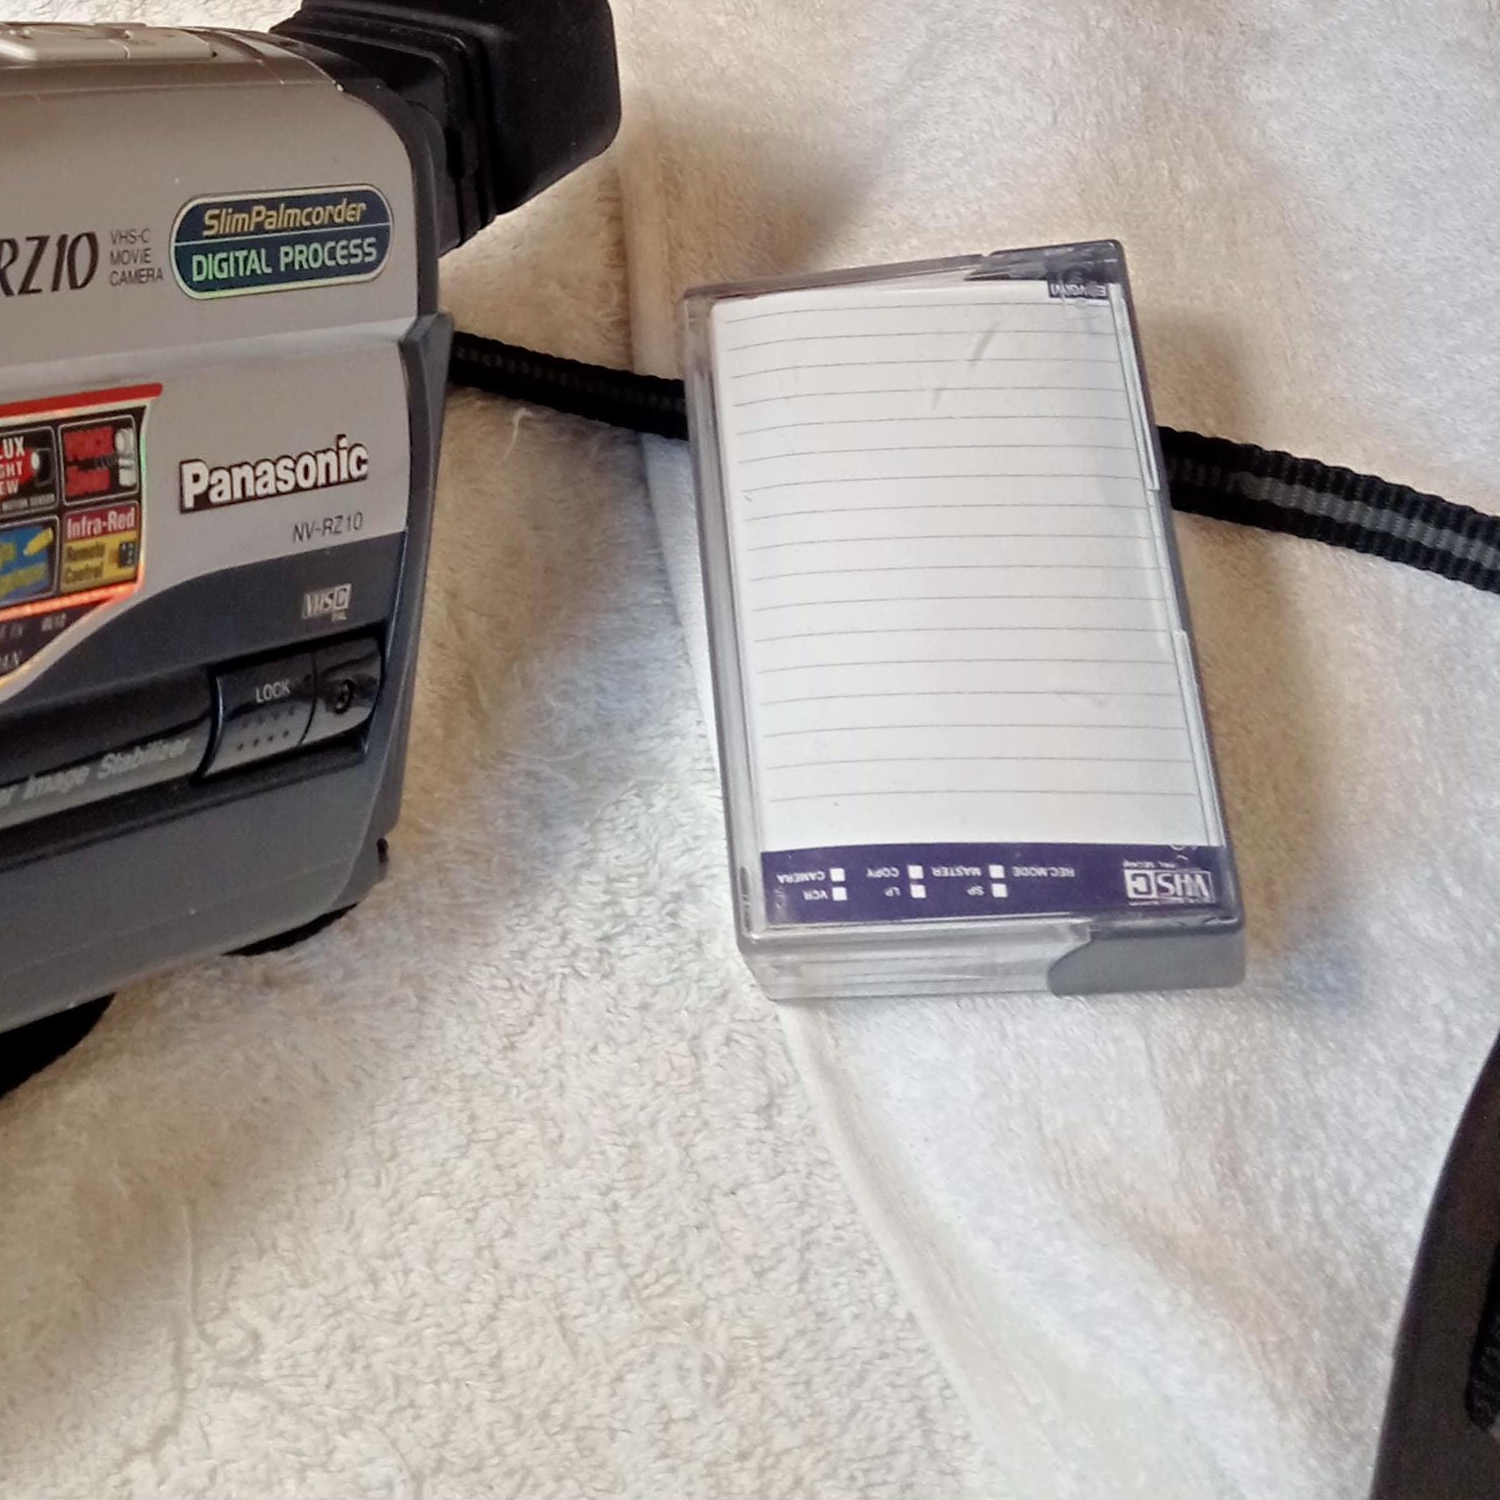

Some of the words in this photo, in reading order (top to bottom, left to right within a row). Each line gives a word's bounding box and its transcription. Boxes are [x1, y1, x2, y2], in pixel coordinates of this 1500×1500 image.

[203, 199, 368, 238] SlimPalmcorder
[110, 228, 151, 246] VHS-C
[110, 248, 152, 266] MOVIE
[192, 252, 273, 283] DIGITAL
[279, 237, 378, 273] PROCESS
[109, 268, 164, 286] CAMERA
[180, 436, 368, 512] Panasonic
[67, 506, 135, 539] Infra-Red
[293, 512, 363, 543] NV-RZ10
[256, 679, 290, 703] LOCK
[776, 870, 826, 885] CAMERA
[866, 866, 900, 880] COPY
[931, 865, 982, 880] MASTER
[803, 887, 830, 900] VCR
[966, 884, 985, 896] SP
